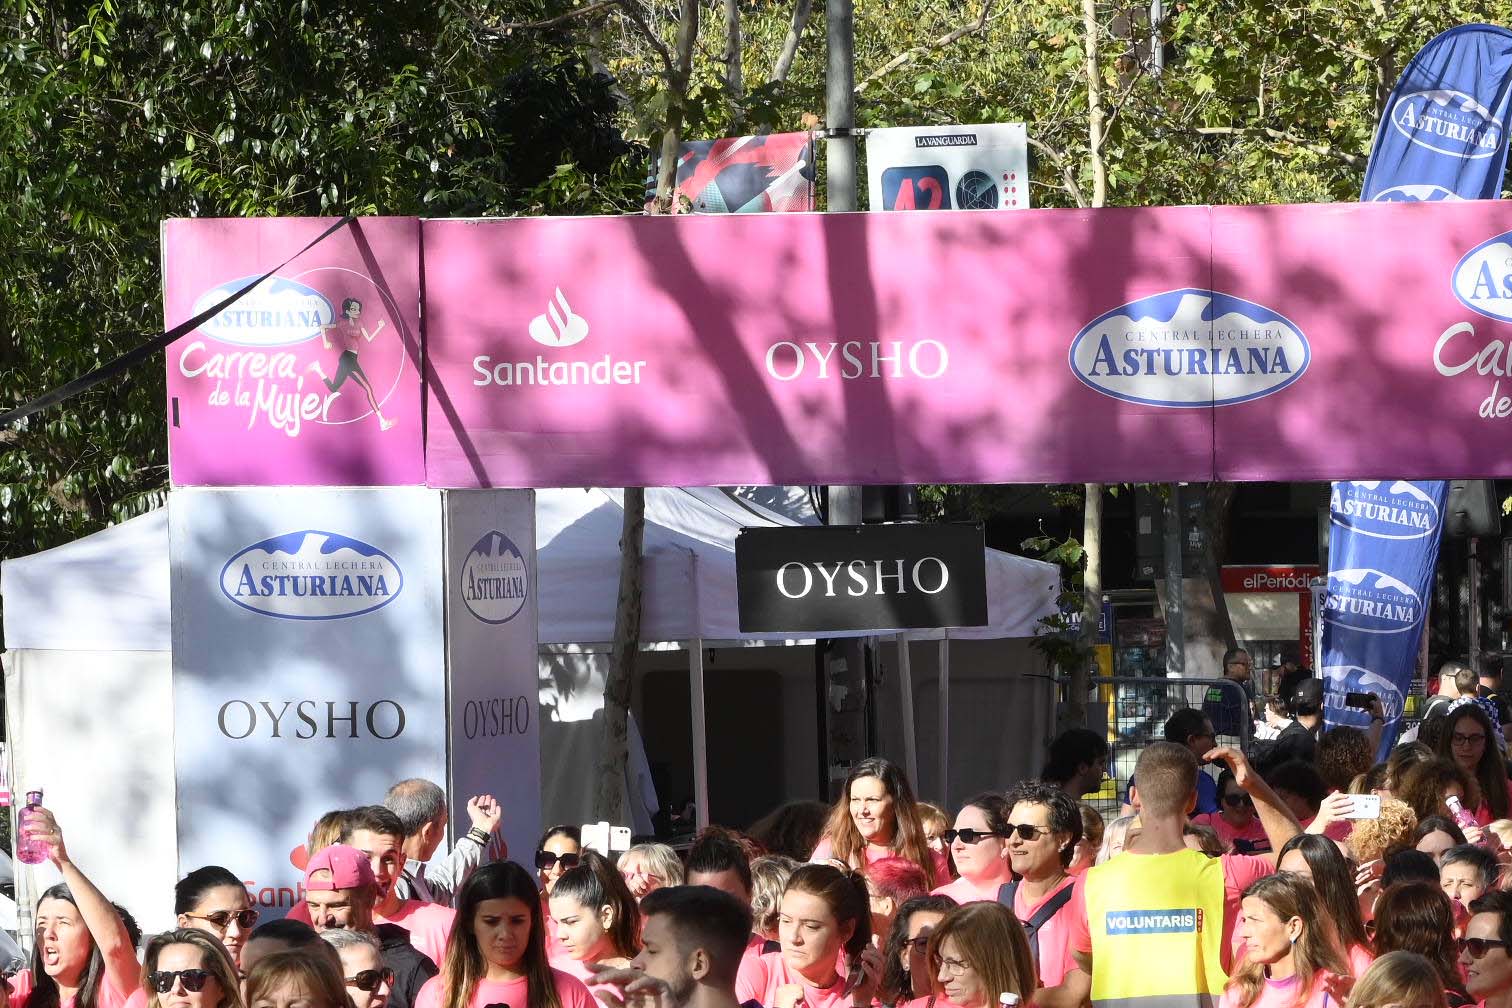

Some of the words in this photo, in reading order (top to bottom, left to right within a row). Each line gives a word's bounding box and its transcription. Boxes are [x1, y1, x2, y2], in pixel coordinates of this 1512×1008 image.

[1399, 103, 1496, 149] ASTURIANA
[1125, 330, 1200, 342] CENTRAL
[1208, 328, 1283, 341] LECHERA
[179, 341, 297, 378] Carrera
[473, 355, 646, 387] Santander
[765, 339, 949, 380] OYSHO
[1088, 333, 1291, 376] ASTURIANA
[208, 380, 228, 407] de
[235, 379, 250, 407] la
[248, 372, 342, 437] Mujer
[1478, 378, 1512, 418] de
[1330, 488, 1430, 529] ASTURIANA
[1347, 489, 1388, 503] CENTRAL
[1391, 498, 1429, 510] LECHERA
[235, 563, 389, 597] ASTURIANA
[262, 561, 320, 571] CENTRAL
[326, 561, 384, 571] LECHERA
[467, 566, 525, 601] ASTURIANA
[776, 557, 949, 599] OYSHO
[1243, 573, 1312, 589] elPeriódi
[1332, 585, 1372, 598] CENTRAL
[217, 700, 406, 740] OYSHO
[464, 695, 530, 740] OYSHO
[1107, 914, 1194, 930] VOLUNTARIS
